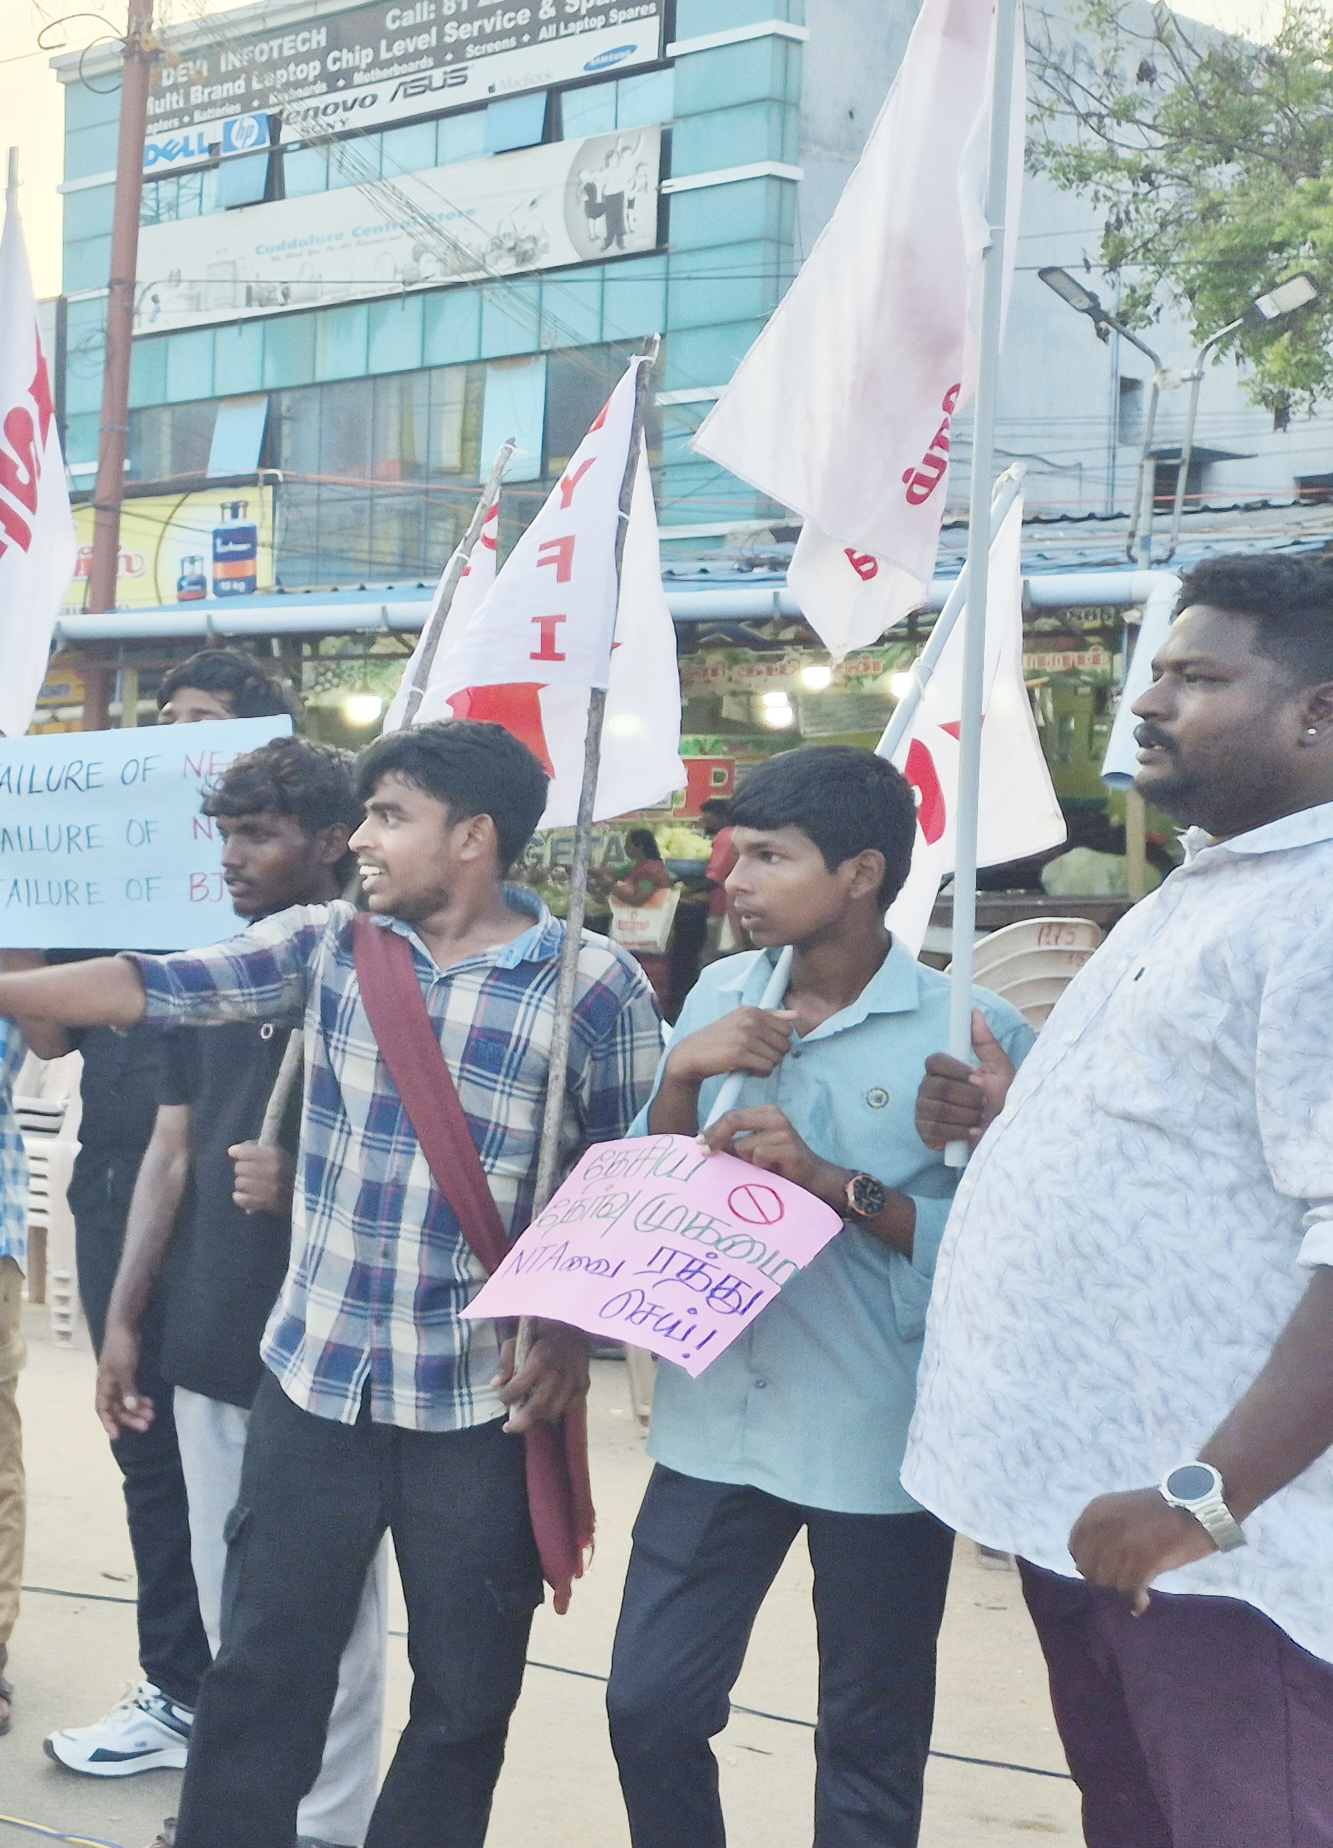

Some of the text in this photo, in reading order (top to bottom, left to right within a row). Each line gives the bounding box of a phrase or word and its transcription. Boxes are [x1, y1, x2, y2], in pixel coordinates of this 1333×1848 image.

[190, 76, 246, 106] Brand
[326, 45, 374, 73] Chip
[379, 27, 437, 61] Level
[444, 8, 531, 44] Service
[220, 26, 328, 73] INFOTECH
[385, 3, 436, 31] Call:
[465, 36, 517, 61] Screens
[538, 25, 556, 42] All
[559, 15, 606, 35] Laptop
[609, 2, 658, 24] Spares
[144, 131, 210, 168] DELL
[283, 93, 379, 126] enovo
[390, 66, 470, 102] ASUS
[121, 754, 162, 786] OF
[125, 819, 162, 847] OF
[124, 876, 163, 903] OF
[188, 871, 226, 903] BJ
